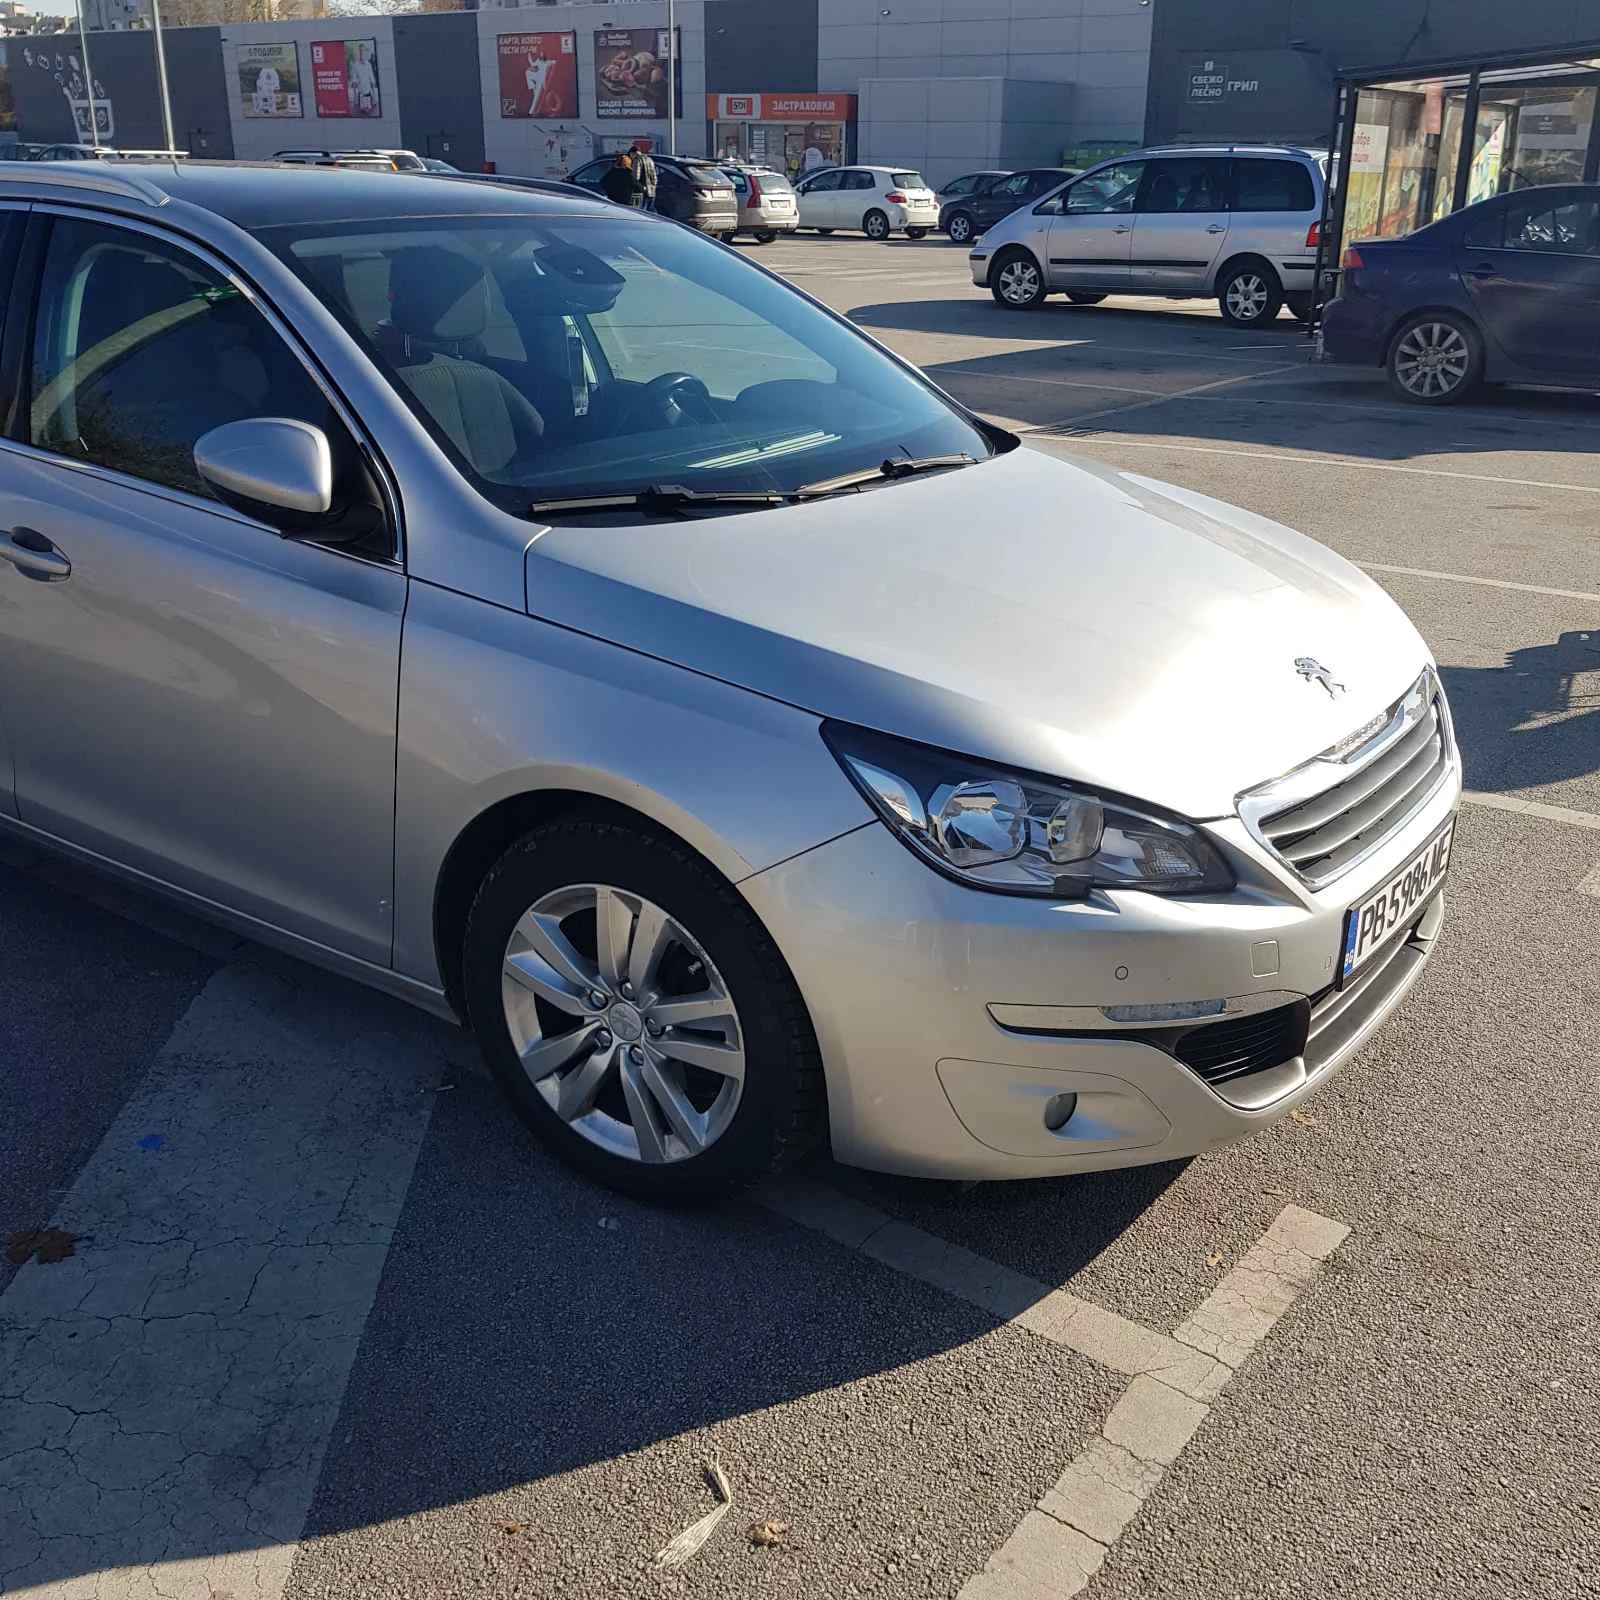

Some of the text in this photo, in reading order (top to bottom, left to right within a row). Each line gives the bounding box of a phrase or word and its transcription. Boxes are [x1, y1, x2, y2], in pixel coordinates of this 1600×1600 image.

[1191, 75, 1224, 85] СВЕЖО
[1227, 80, 1259, 92] ГРИЛ
[1191, 87, 1222, 97] ЛЕСНО
[772, 100, 835, 113] ЗАСТРАХОВКИ
[1357, 895, 1386, 957] PB
[1387, 852, 1428, 929] 5986
